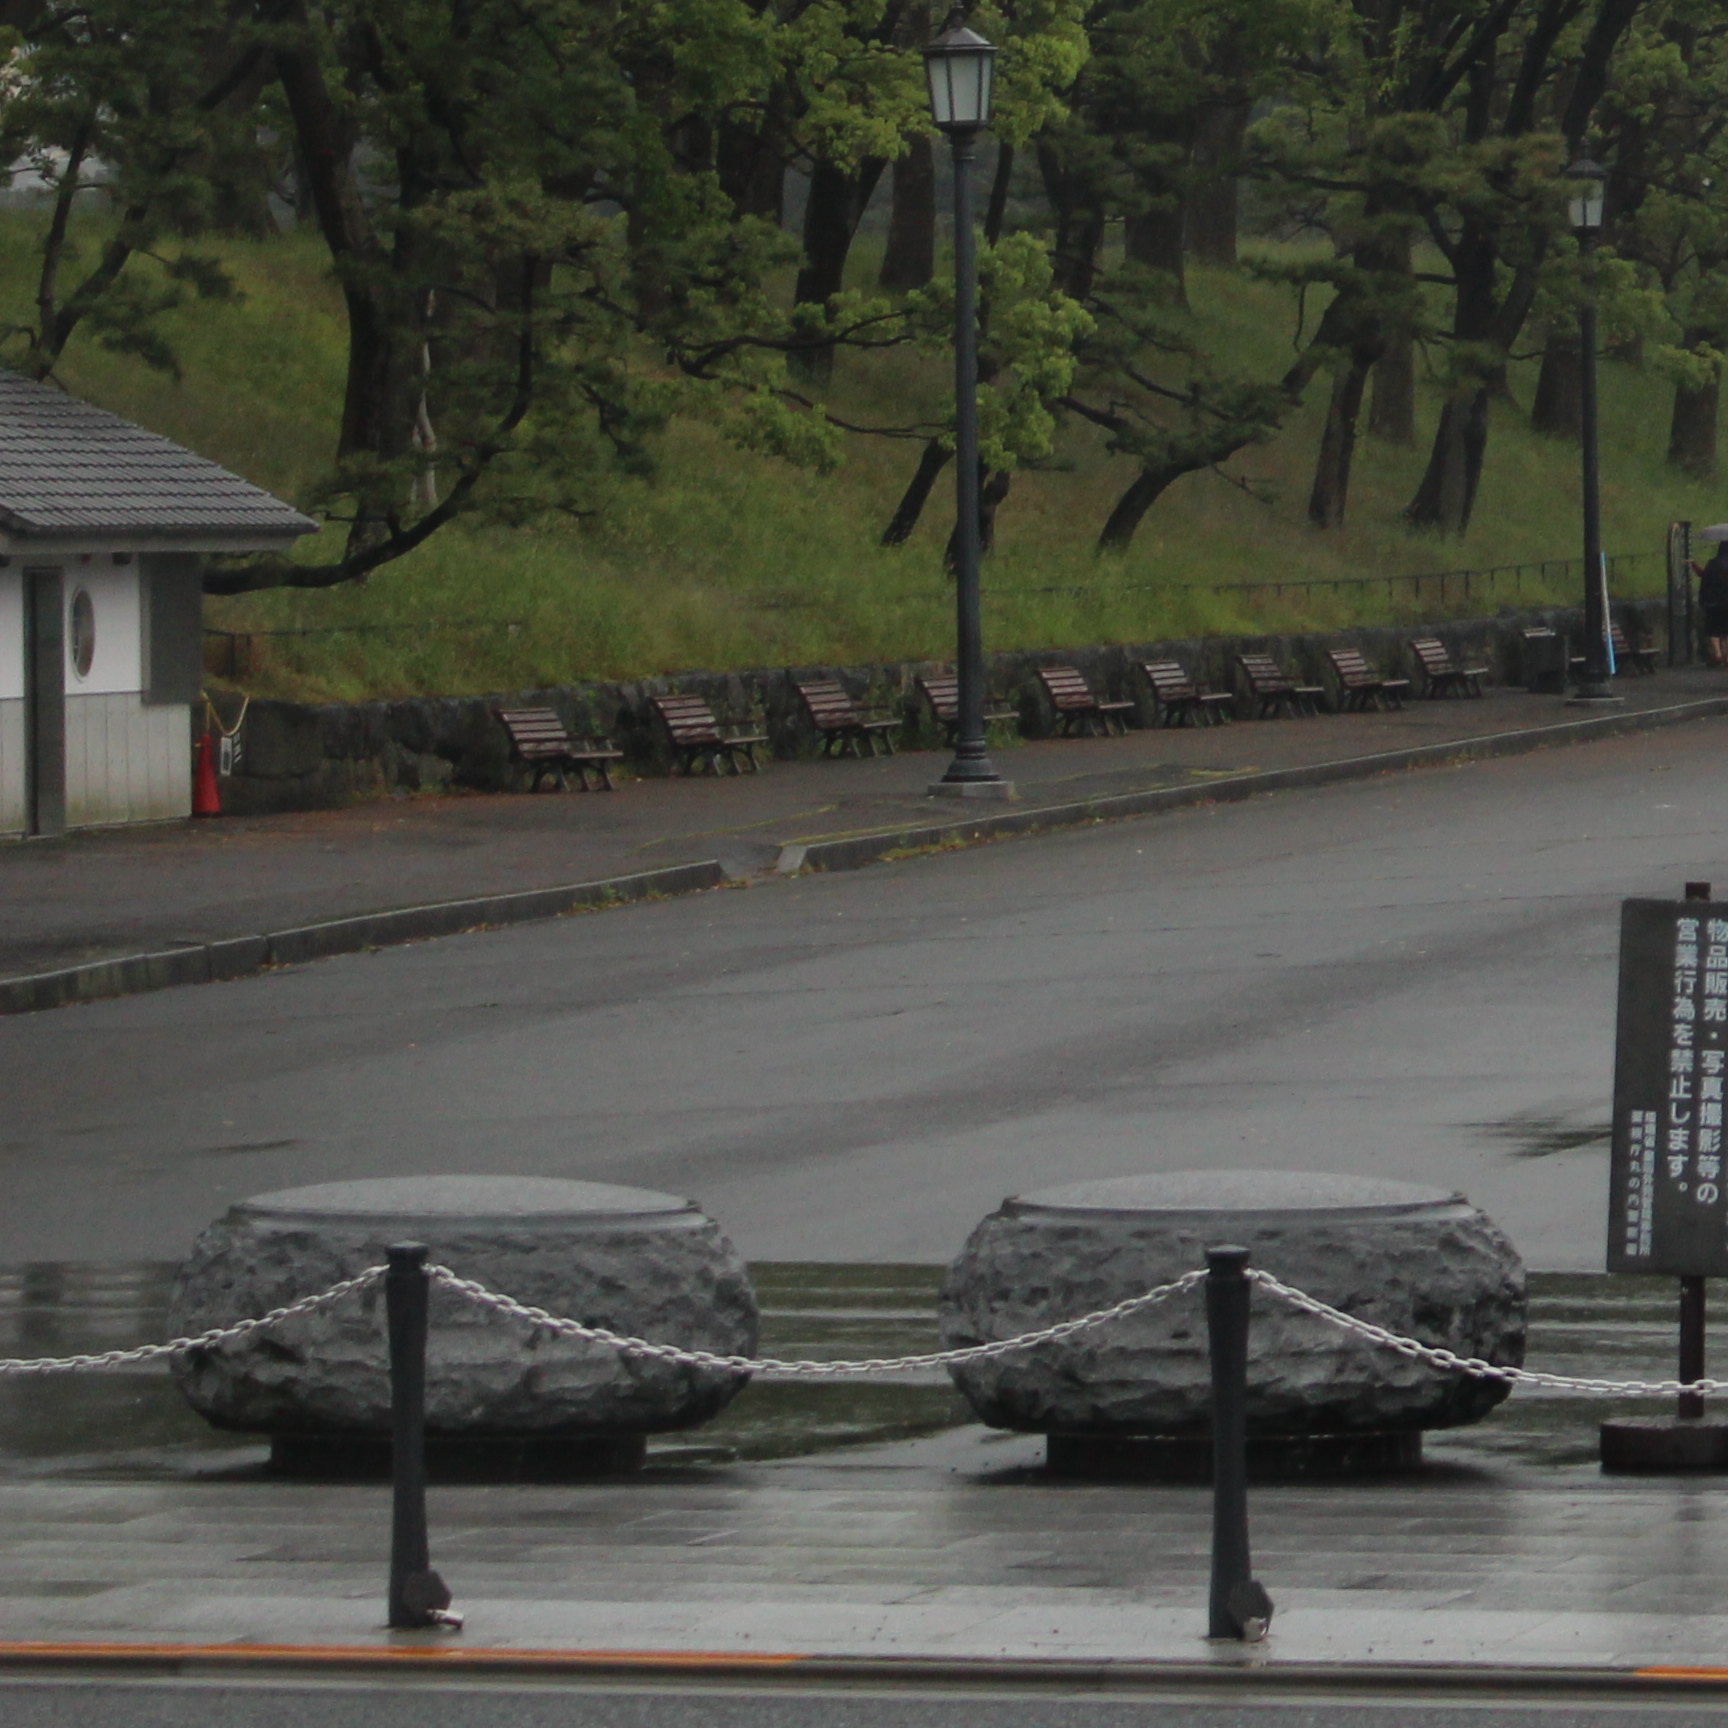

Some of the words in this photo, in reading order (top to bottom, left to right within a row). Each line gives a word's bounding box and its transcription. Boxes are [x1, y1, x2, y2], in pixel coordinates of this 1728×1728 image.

[1667, 917, 1700, 1192] 営業行為を禁止します。
